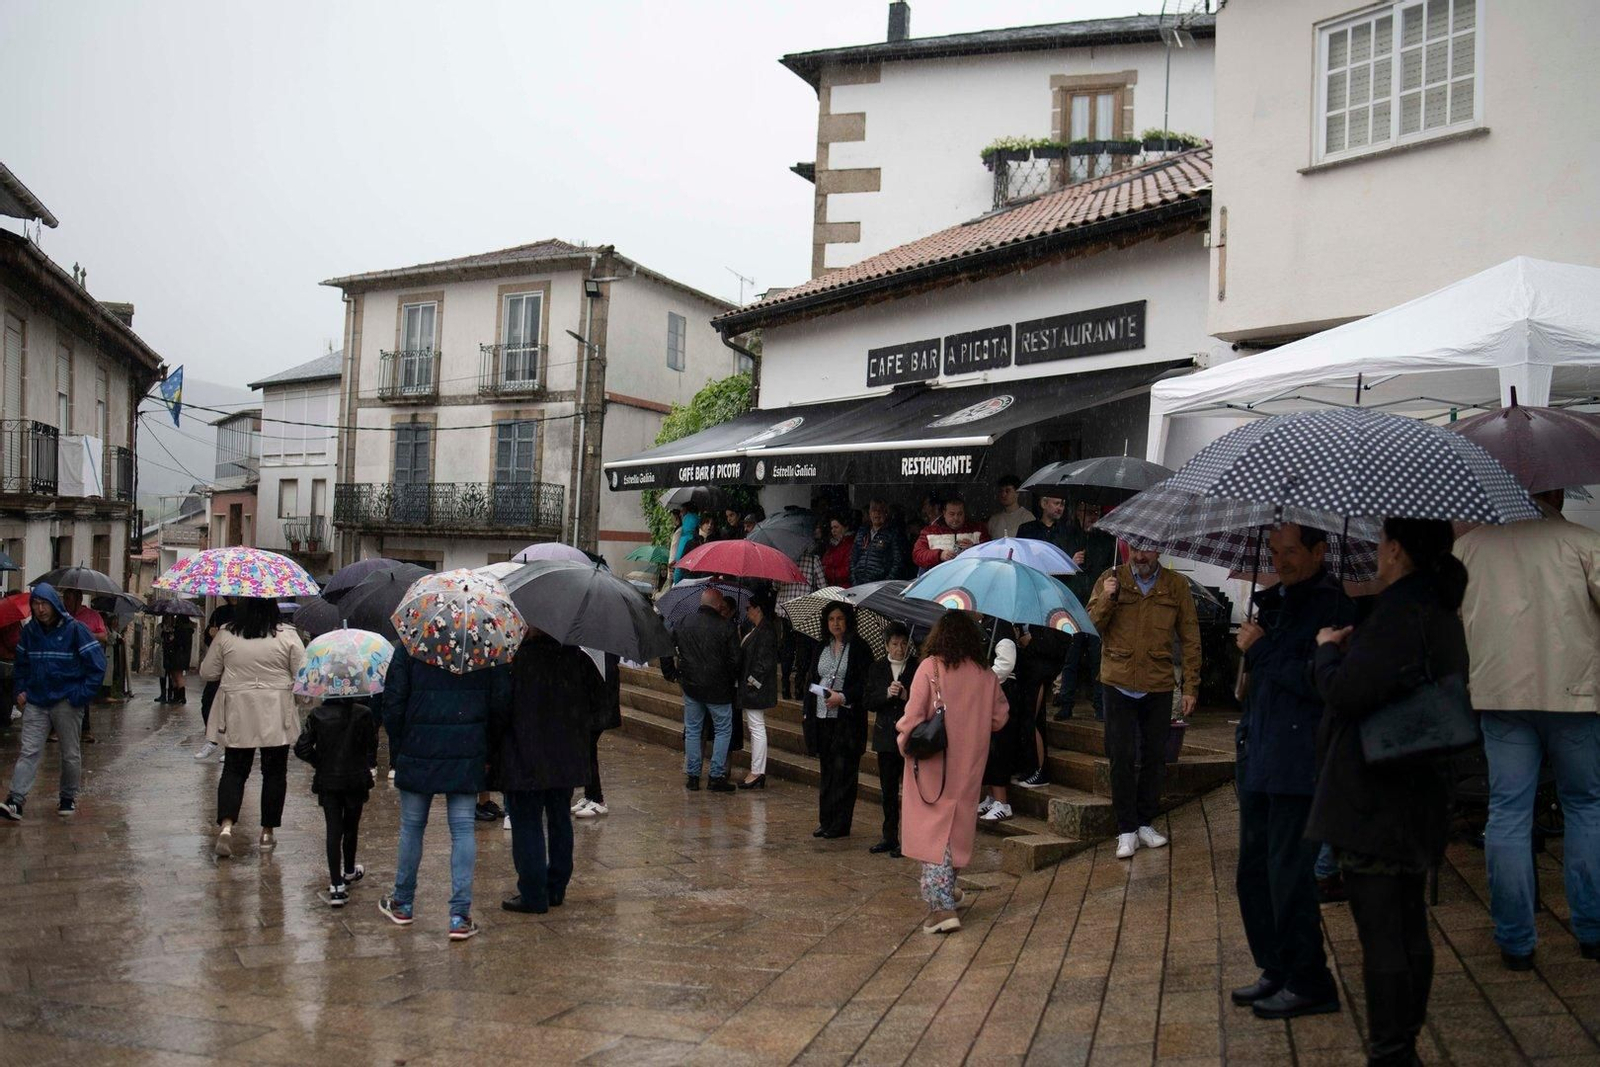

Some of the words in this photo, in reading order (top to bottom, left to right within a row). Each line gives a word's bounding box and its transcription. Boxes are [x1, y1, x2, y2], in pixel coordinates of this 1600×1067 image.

[1021, 314, 1137, 354] RESTAURANTE
[869, 353, 903, 378] CAFE
[911, 348, 937, 371] BAR
[948, 348, 956, 365] A
[961, 338, 1009, 363] PICOTA
[679, 464, 694, 482] CAFÉ
[695, 465, 709, 481] BAR
[710, 465, 715, 479] A
[716, 462, 741, 479] PICOTA
[773, 465, 794, 477] Estrella
[795, 463, 816, 477] Galicia
[901, 455, 972, 476] RESTAURANTE
